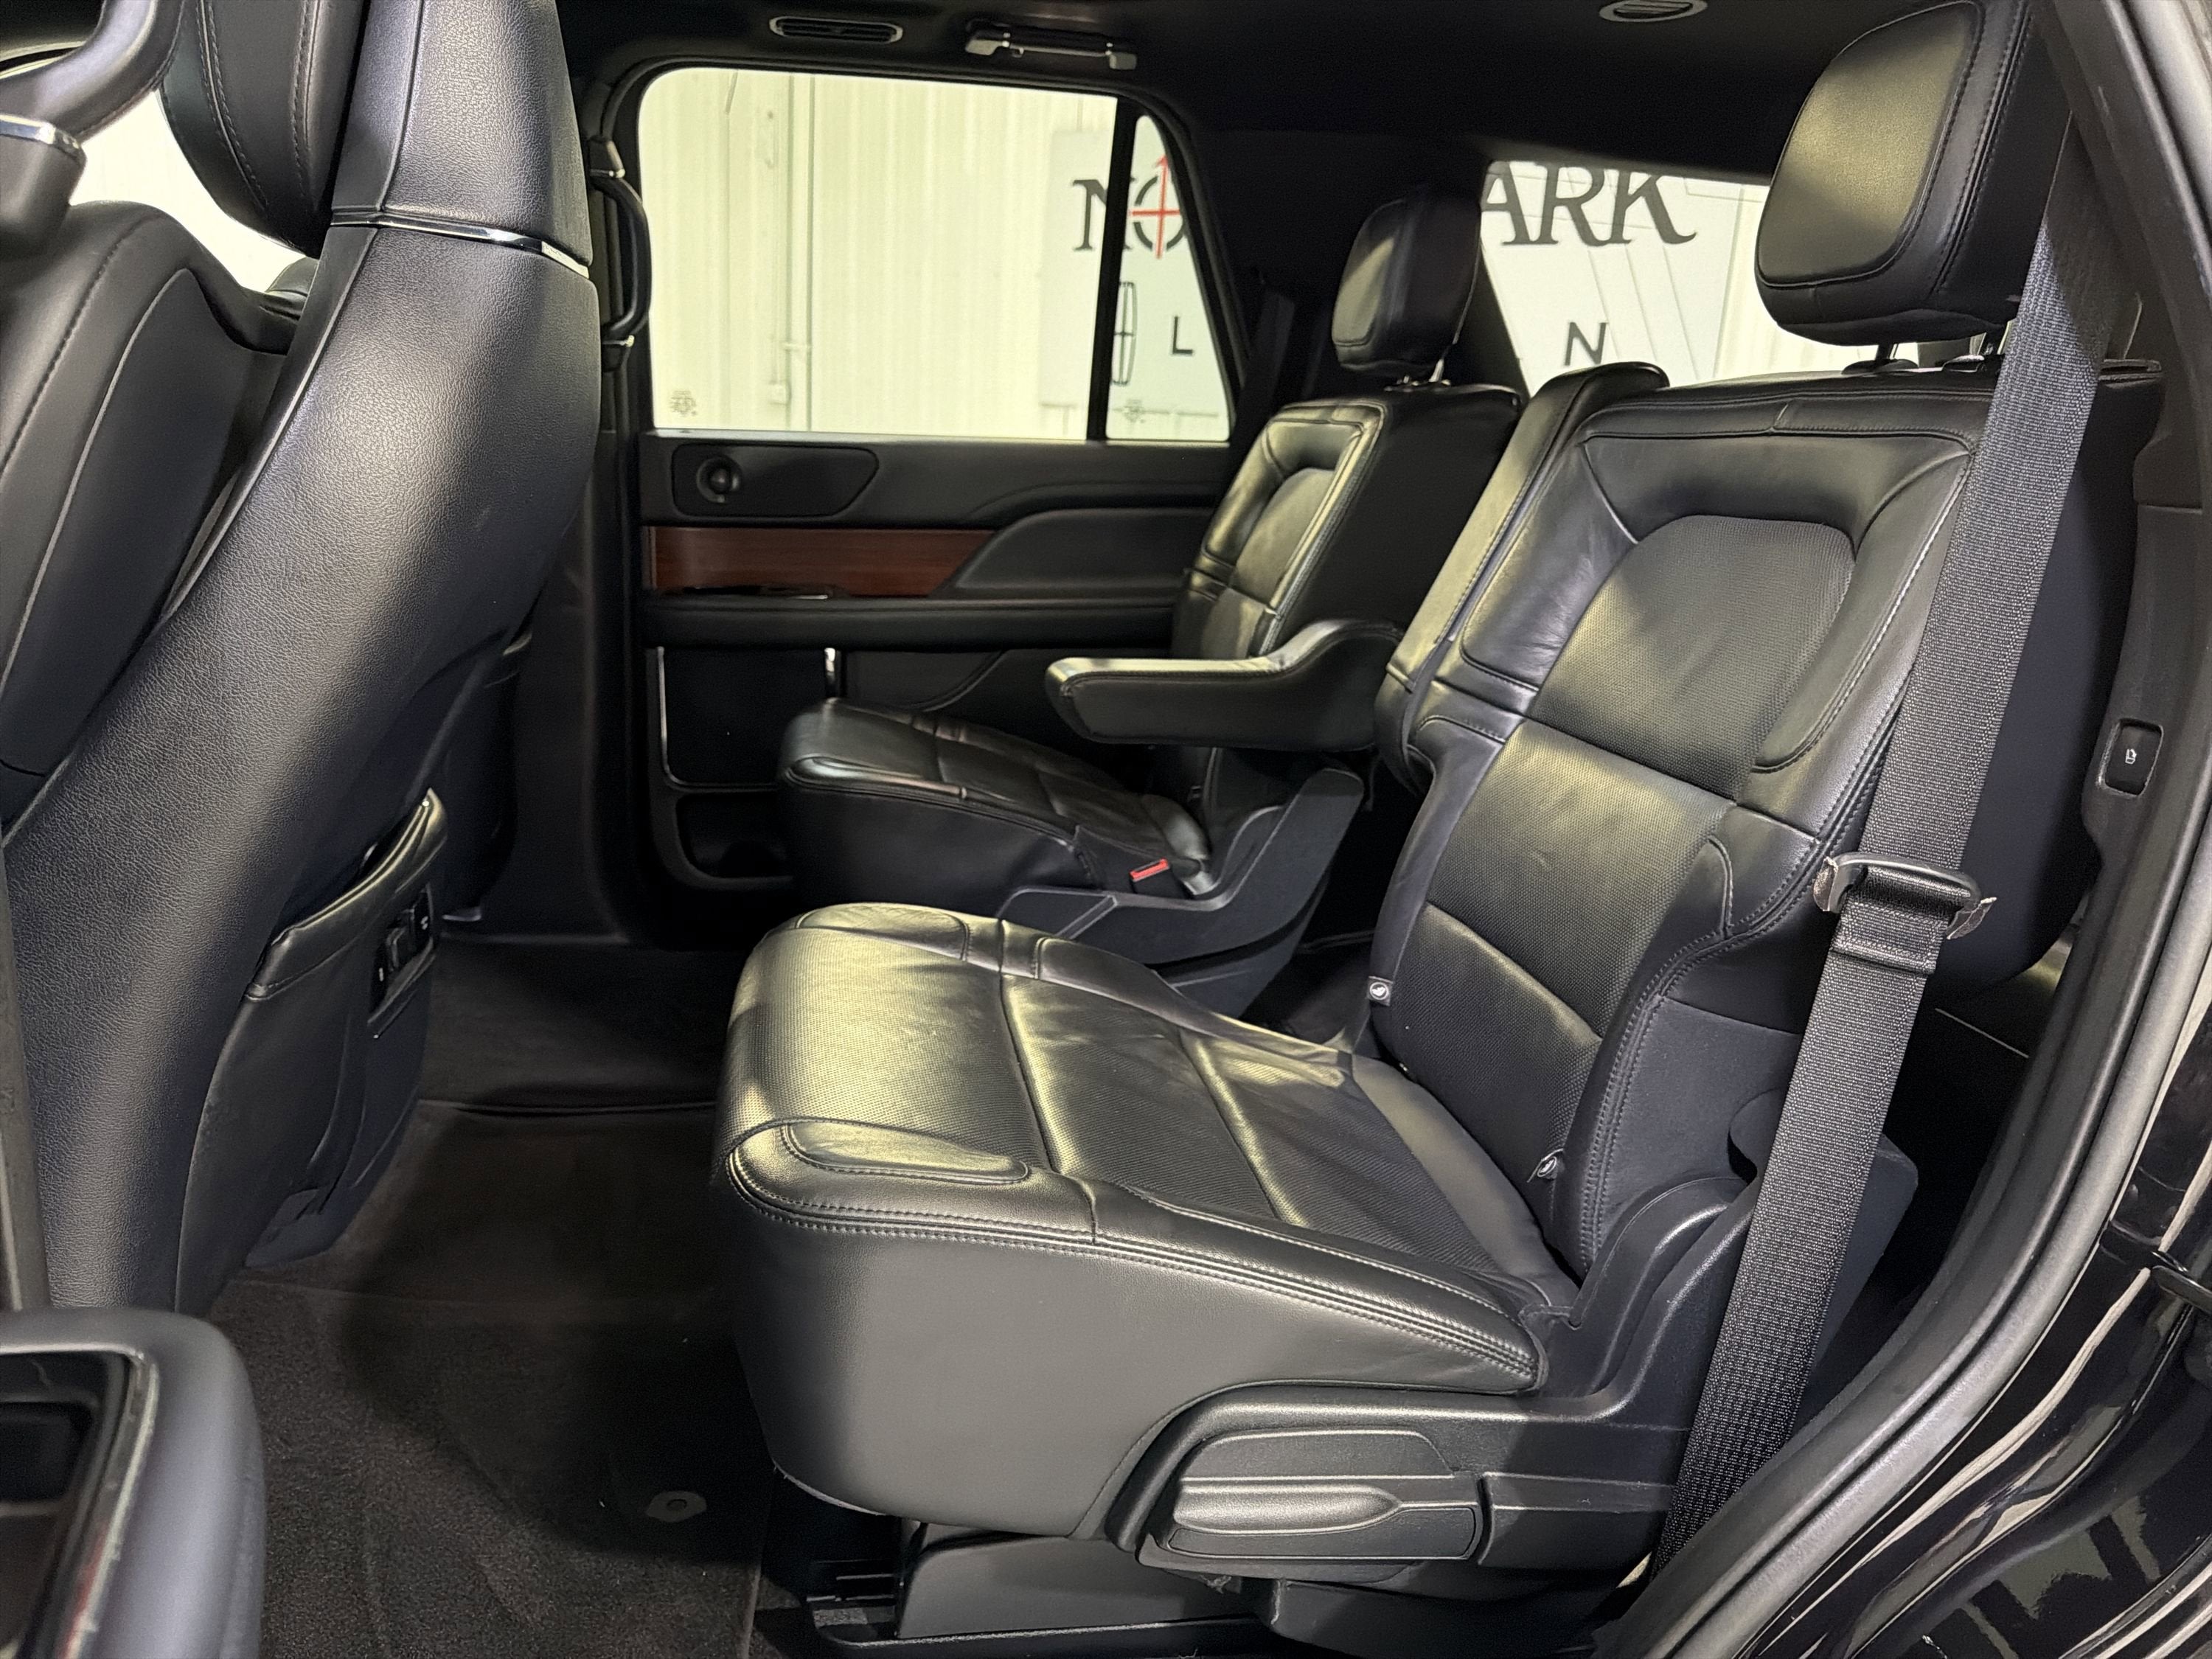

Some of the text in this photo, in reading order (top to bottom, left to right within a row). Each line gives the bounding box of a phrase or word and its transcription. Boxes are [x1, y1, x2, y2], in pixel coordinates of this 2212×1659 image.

[1481, 162, 1697, 246] ARK
[1172, 316, 1607, 366] L N
